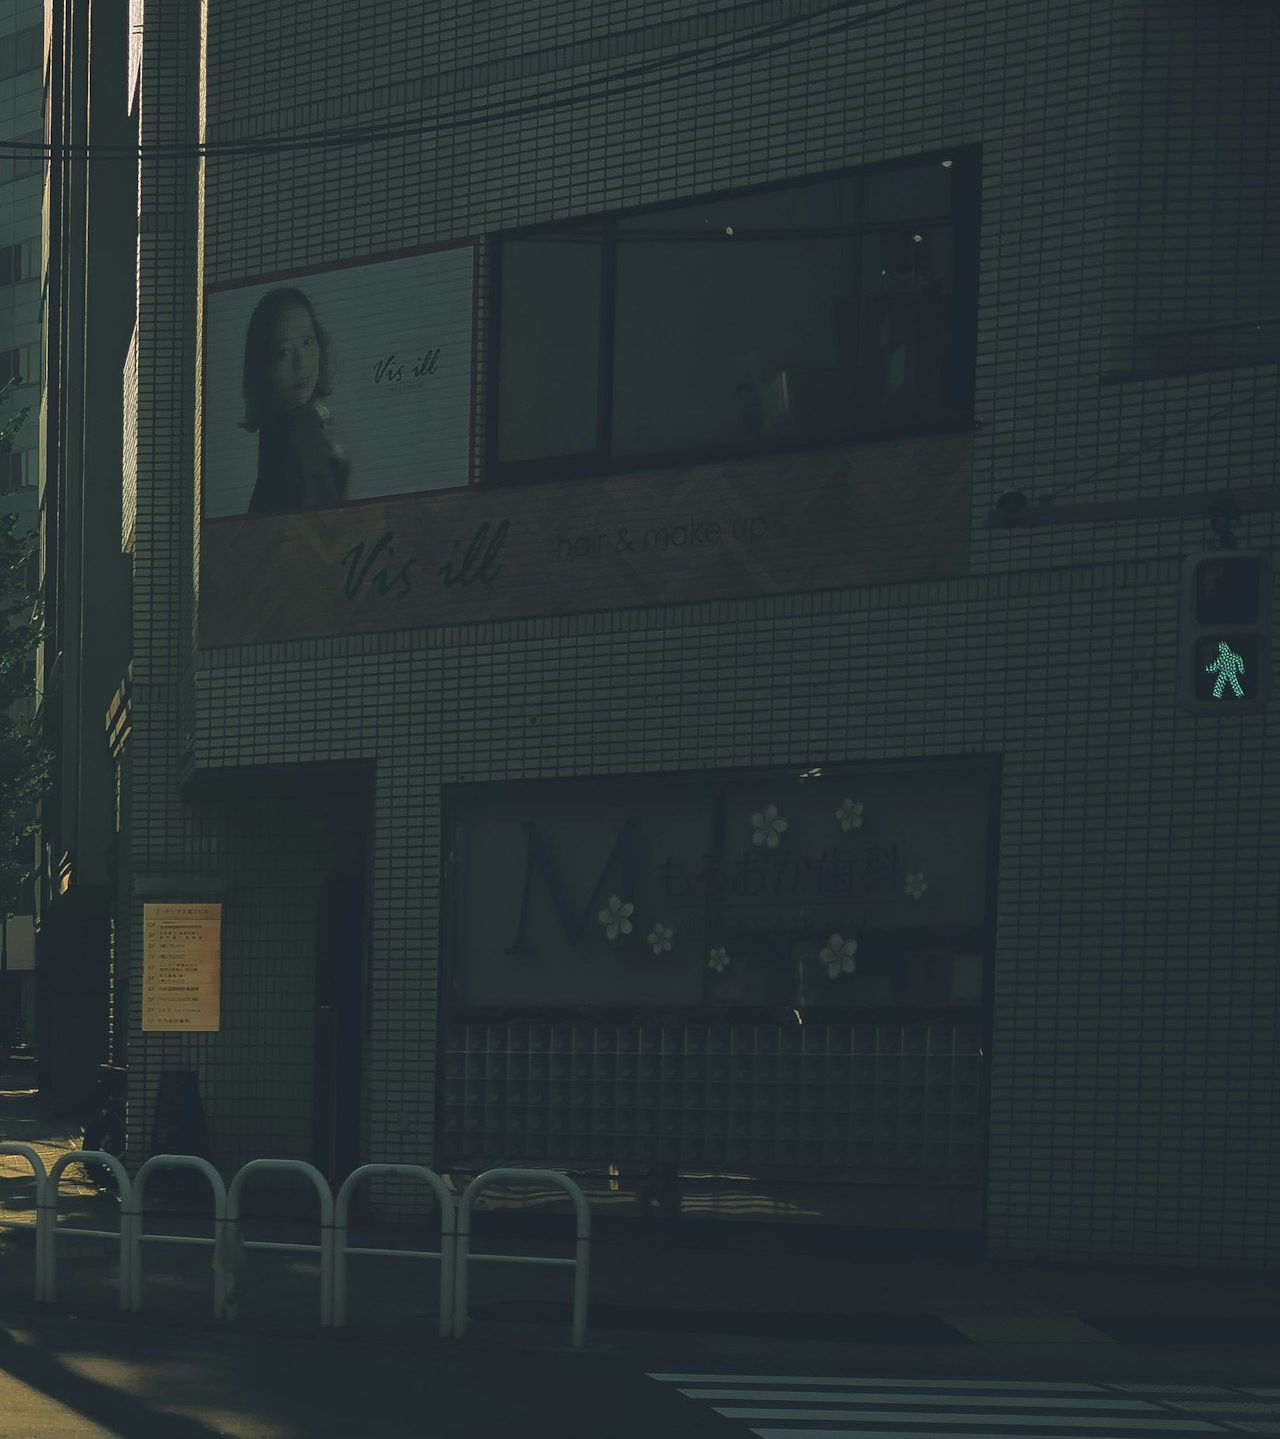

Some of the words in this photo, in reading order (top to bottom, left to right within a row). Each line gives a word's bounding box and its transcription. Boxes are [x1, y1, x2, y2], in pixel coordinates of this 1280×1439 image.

[373, 355, 405, 384] Vis
[412, 348, 441, 378] ill
[338, 530, 414, 602] Vis
[437, 519, 512, 591] ill
[556, 528, 607, 559] hair
[615, 527, 633, 553] &
[643, 517, 721, 550] make
[731, 516, 769, 545] up
[659, 843, 900, 899] もろおか歯科
